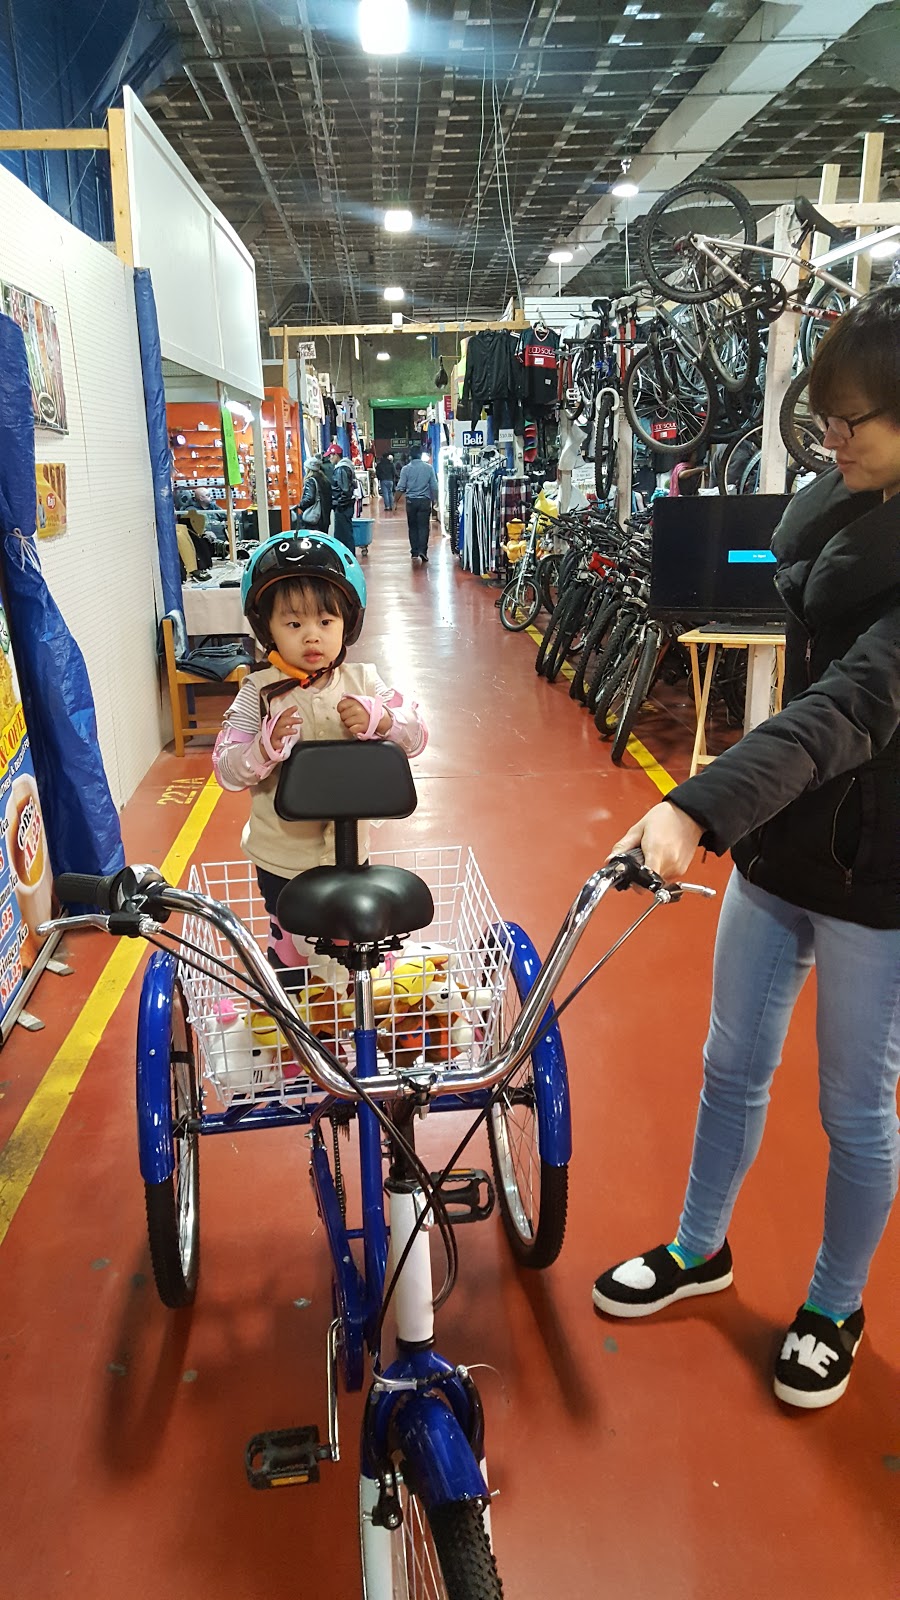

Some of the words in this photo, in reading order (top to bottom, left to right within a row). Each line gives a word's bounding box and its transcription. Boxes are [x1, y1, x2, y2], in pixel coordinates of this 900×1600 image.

[463, 433, 483, 446] Belt
[18, 924, 28, 945] Tea
[780, 1331, 840, 1379] ME
